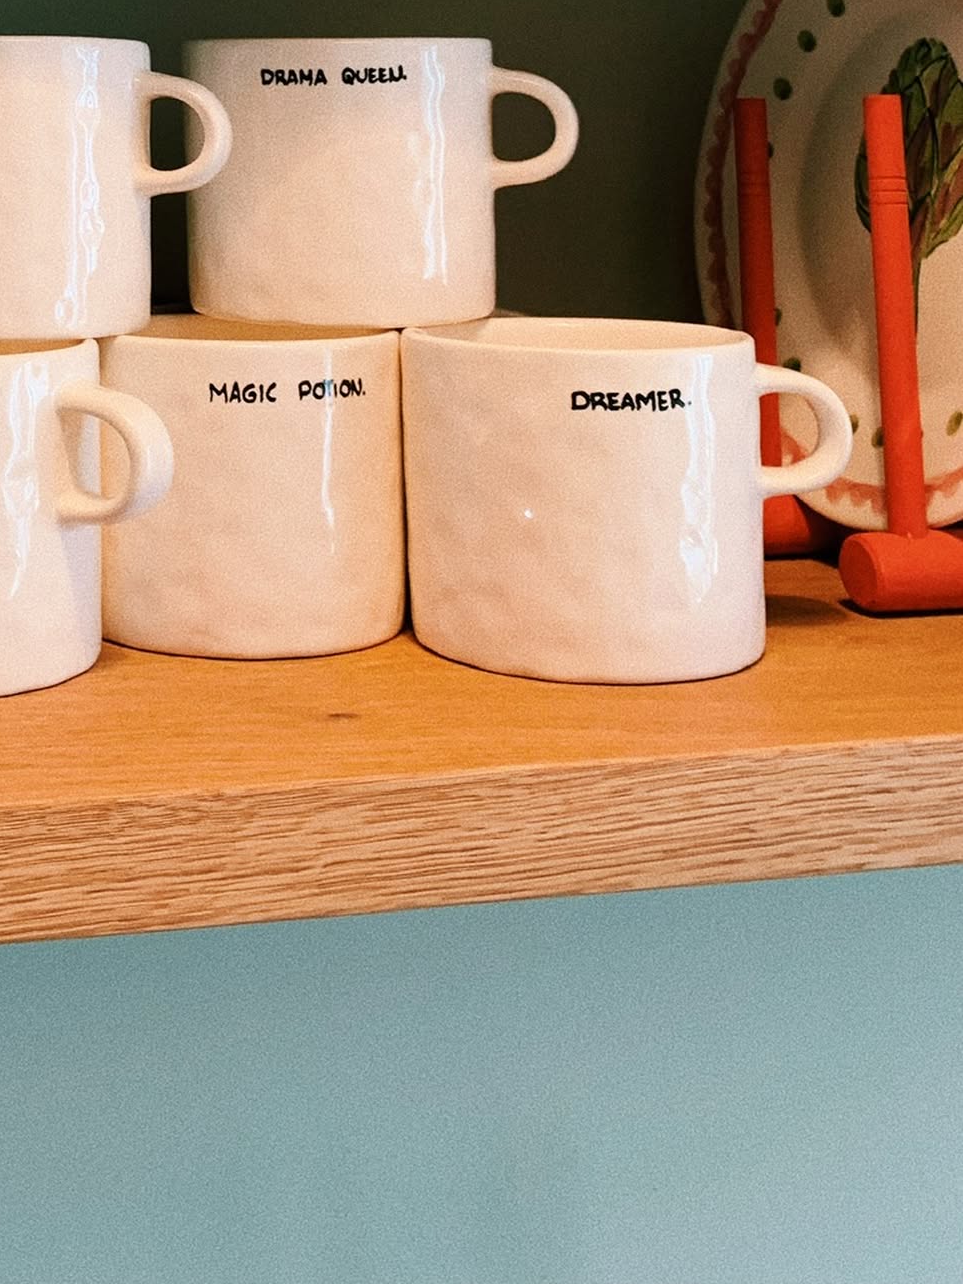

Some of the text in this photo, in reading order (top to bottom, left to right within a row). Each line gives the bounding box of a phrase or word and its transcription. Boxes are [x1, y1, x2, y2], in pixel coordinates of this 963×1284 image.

[260, 68, 328, 87] DRAMA
[209, 377, 367, 404] MAGIC POTION.
[570, 388, 693, 412] DREAMER.
